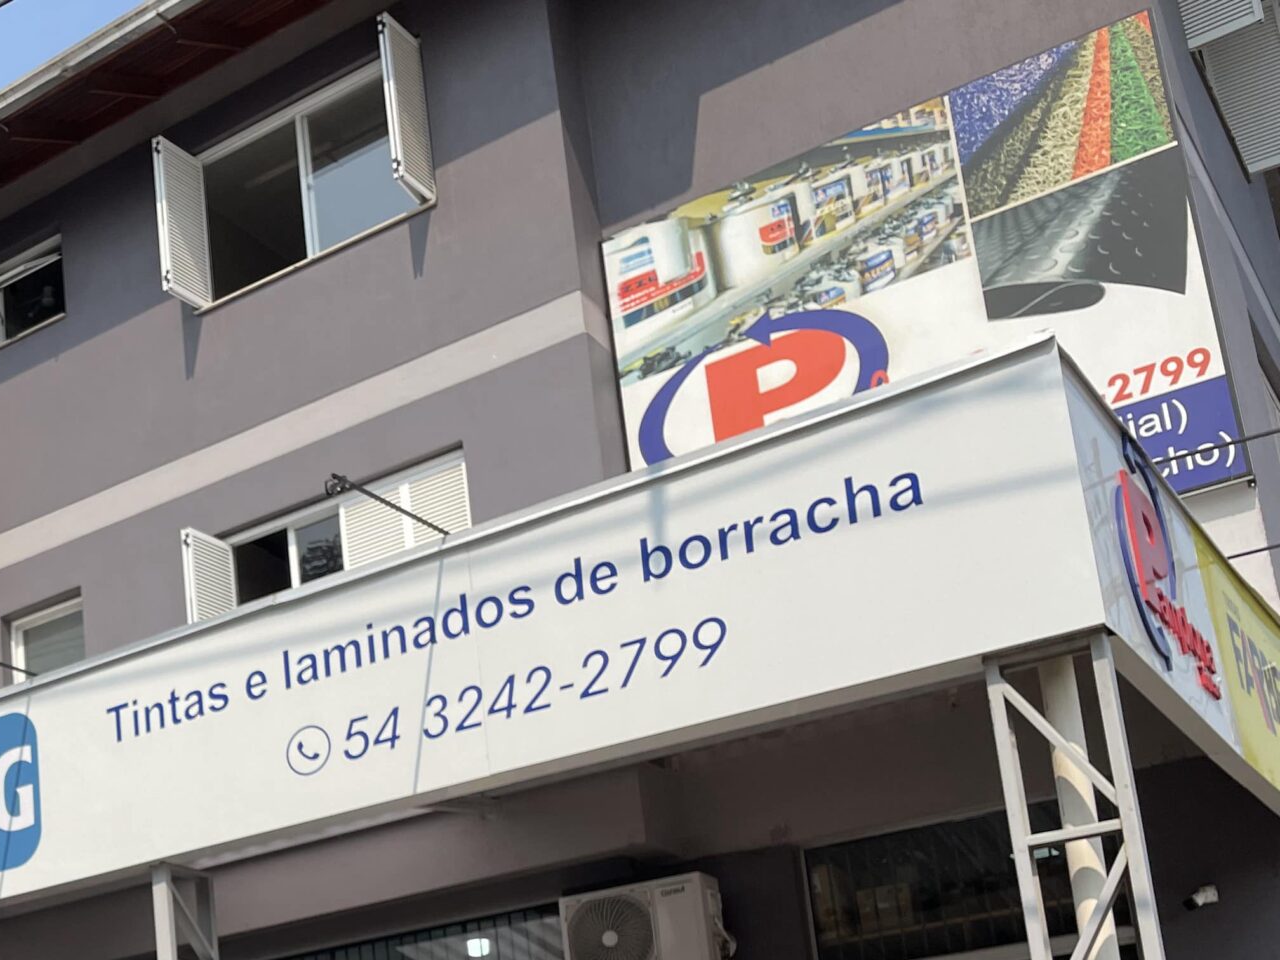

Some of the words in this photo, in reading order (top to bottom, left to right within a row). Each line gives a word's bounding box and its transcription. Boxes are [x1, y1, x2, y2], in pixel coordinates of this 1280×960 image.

[107, 682, 230, 743] Tintas
[245, 670, 268, 701] e
[282, 584, 536, 689] laminados
[554, 557, 619, 605] de
[639, 472, 924, 582] borracha
[343, 706, 401, 760] 54
[422, 617, 727, 740] 3242-2799
